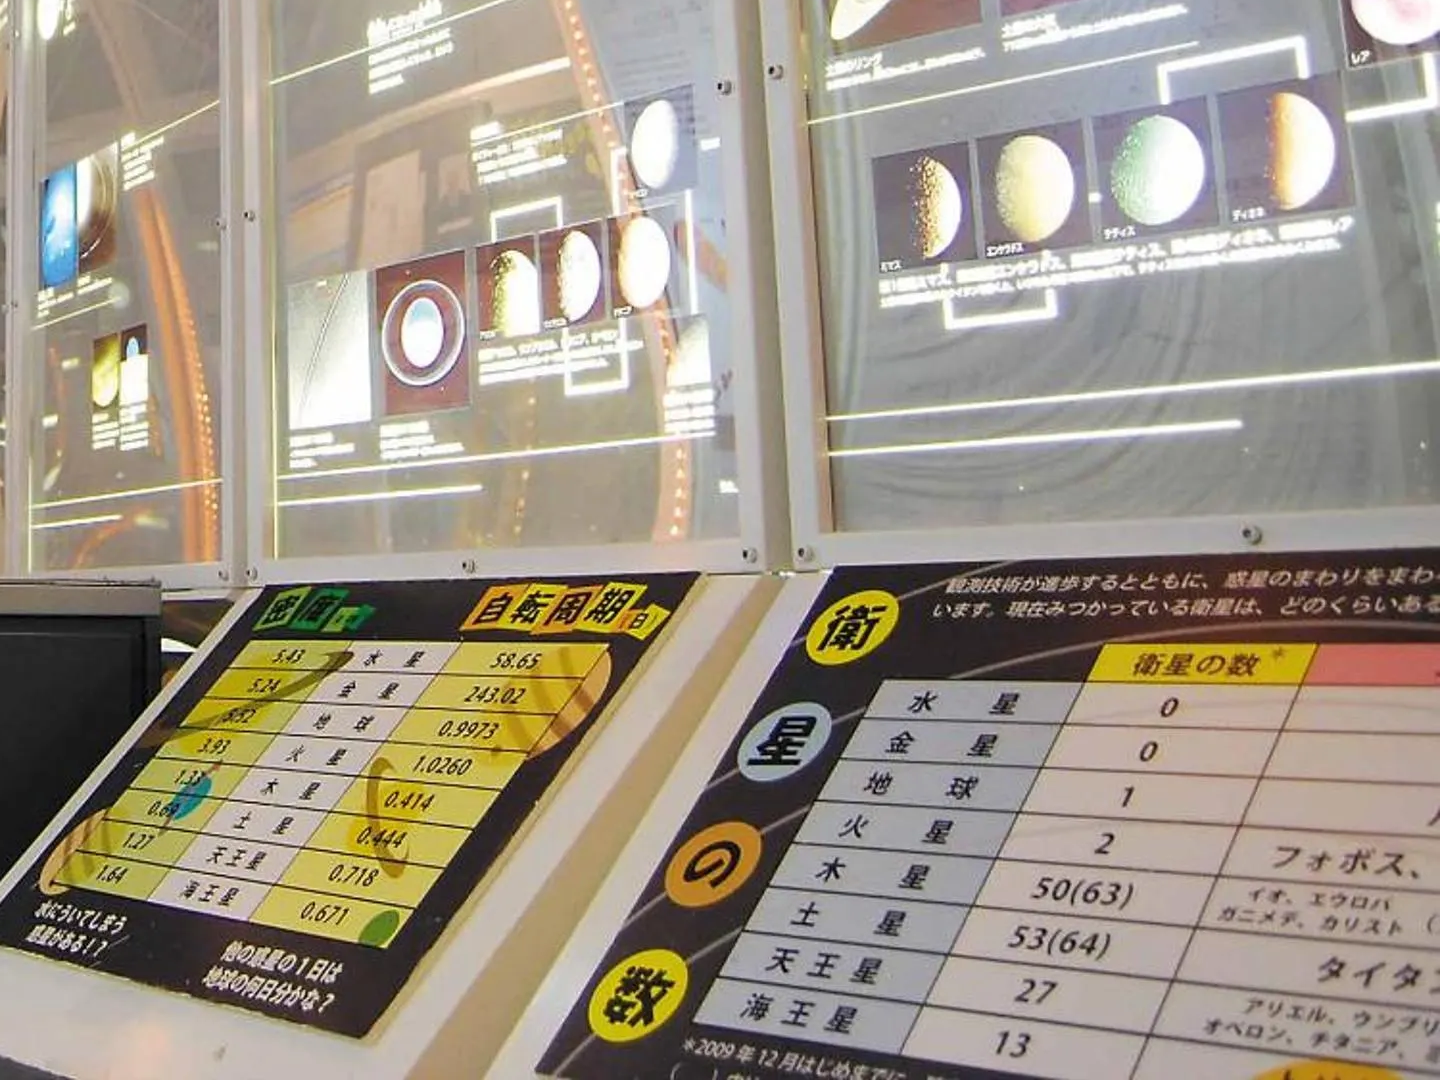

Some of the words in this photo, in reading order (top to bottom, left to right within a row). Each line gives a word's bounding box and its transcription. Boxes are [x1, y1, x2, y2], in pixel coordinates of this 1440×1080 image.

[472, 587, 636, 625] 自転周期
[816, 604, 888, 651] 衛
[272, 648, 307, 664] 5.43
[489, 652, 542, 669] 58.65
[247, 678, 282, 694] 5.24
[464, 686, 526, 704] 243.02
[1160, 697, 1180, 718] 0
[438, 721, 500, 739] 0.9973
[197, 738, 231, 755] 3.93
[412, 756, 473, 776] 1.0260
[1139, 741, 1159, 762] 0
[384, 791, 435, 812] 0.414
[1121, 786, 1136, 808] 1
[357, 826, 408, 849] 0.444
[1094, 832, 1115, 855] 2
[122, 831, 156, 850] 1.27
[205, 846, 267, 871] 天王星
[328, 864, 379, 887] 0.718
[96, 864, 129, 884] 1.64
[301, 902, 350, 926] 0.671
[1031, 876, 1134, 909] 50(63)
[1007, 925, 1112, 961] 53(64)
[765, 947, 882, 986] 天王星
[1013, 978, 1059, 1004] 27
[739, 992, 859, 1036] 海王星
[994, 1029, 1033, 1059] 13
